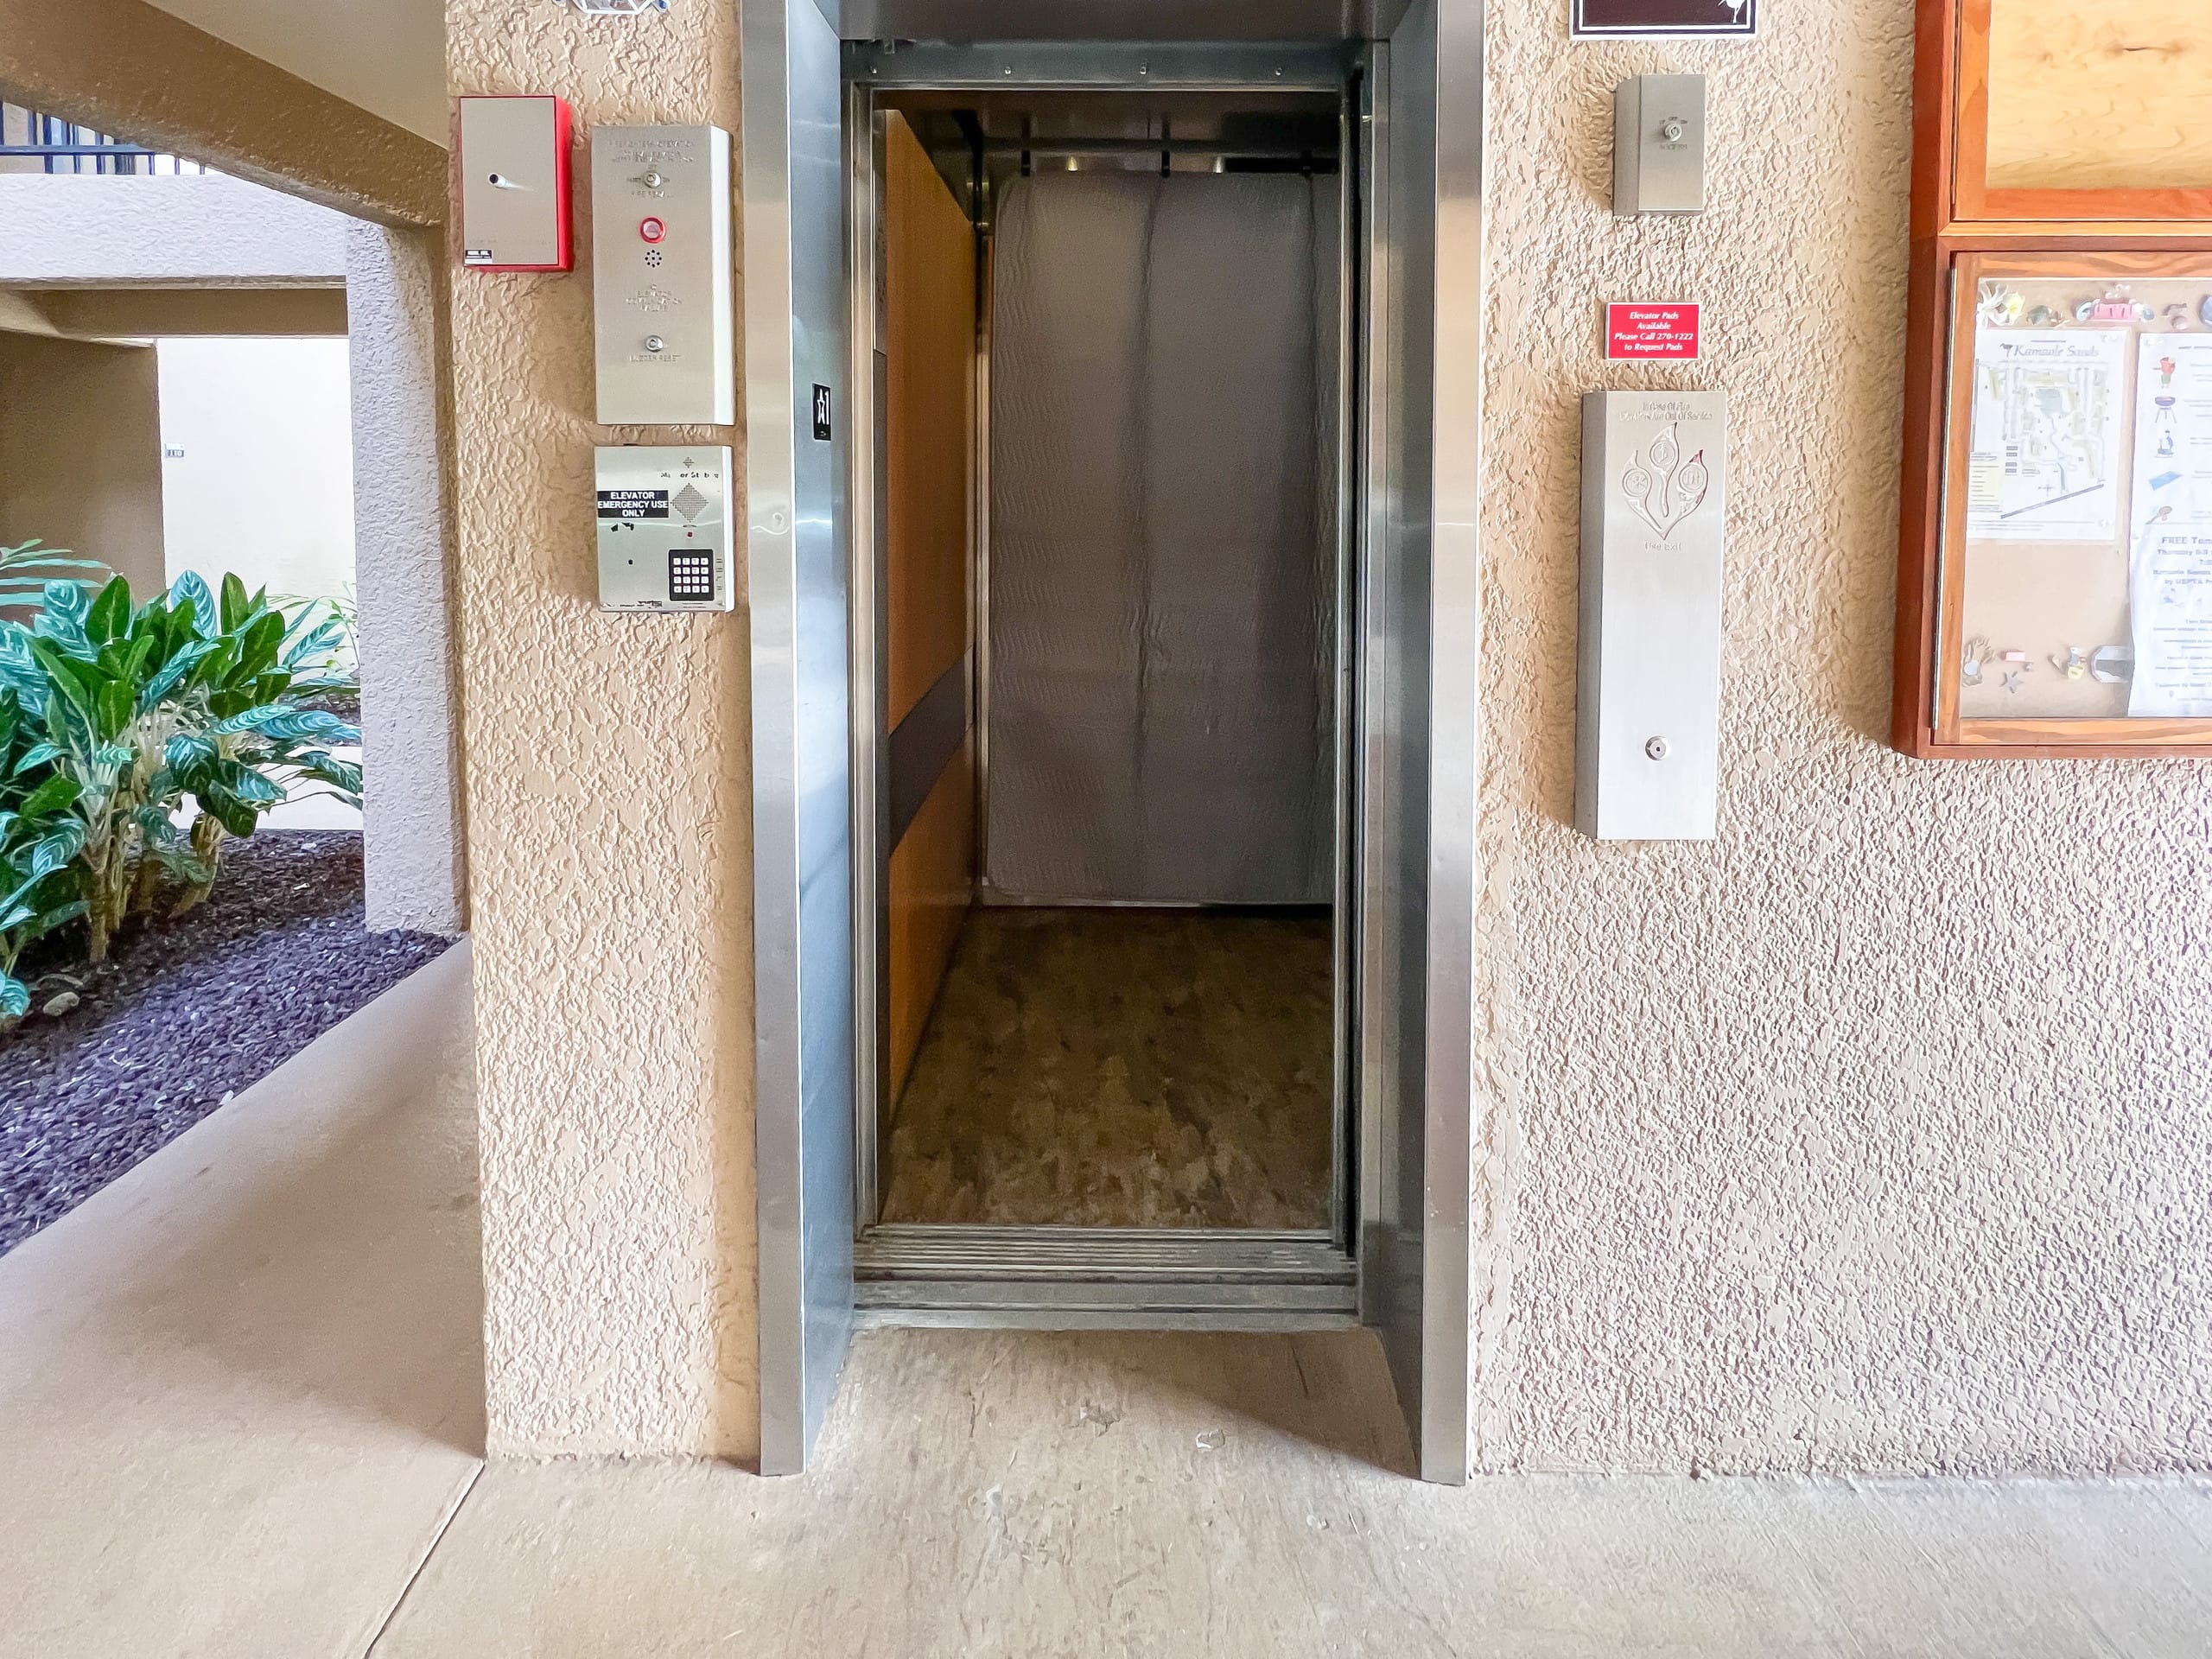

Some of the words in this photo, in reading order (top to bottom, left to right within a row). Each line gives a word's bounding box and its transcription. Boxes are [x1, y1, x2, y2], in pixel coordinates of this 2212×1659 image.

[1630, 311, 1660, 320] Elevator
[1662, 311, 1679, 320] Pads
[1637, 321, 1672, 330] Available
[1614, 332, 1638, 340] Please
[1639, 332, 1656, 340] Call
[1656, 332, 1694, 340] 270-1222
[1634, 342, 1664, 353] Request
[1665, 342, 1684, 351] Pads
[622, 509, 645, 518] ONLY
